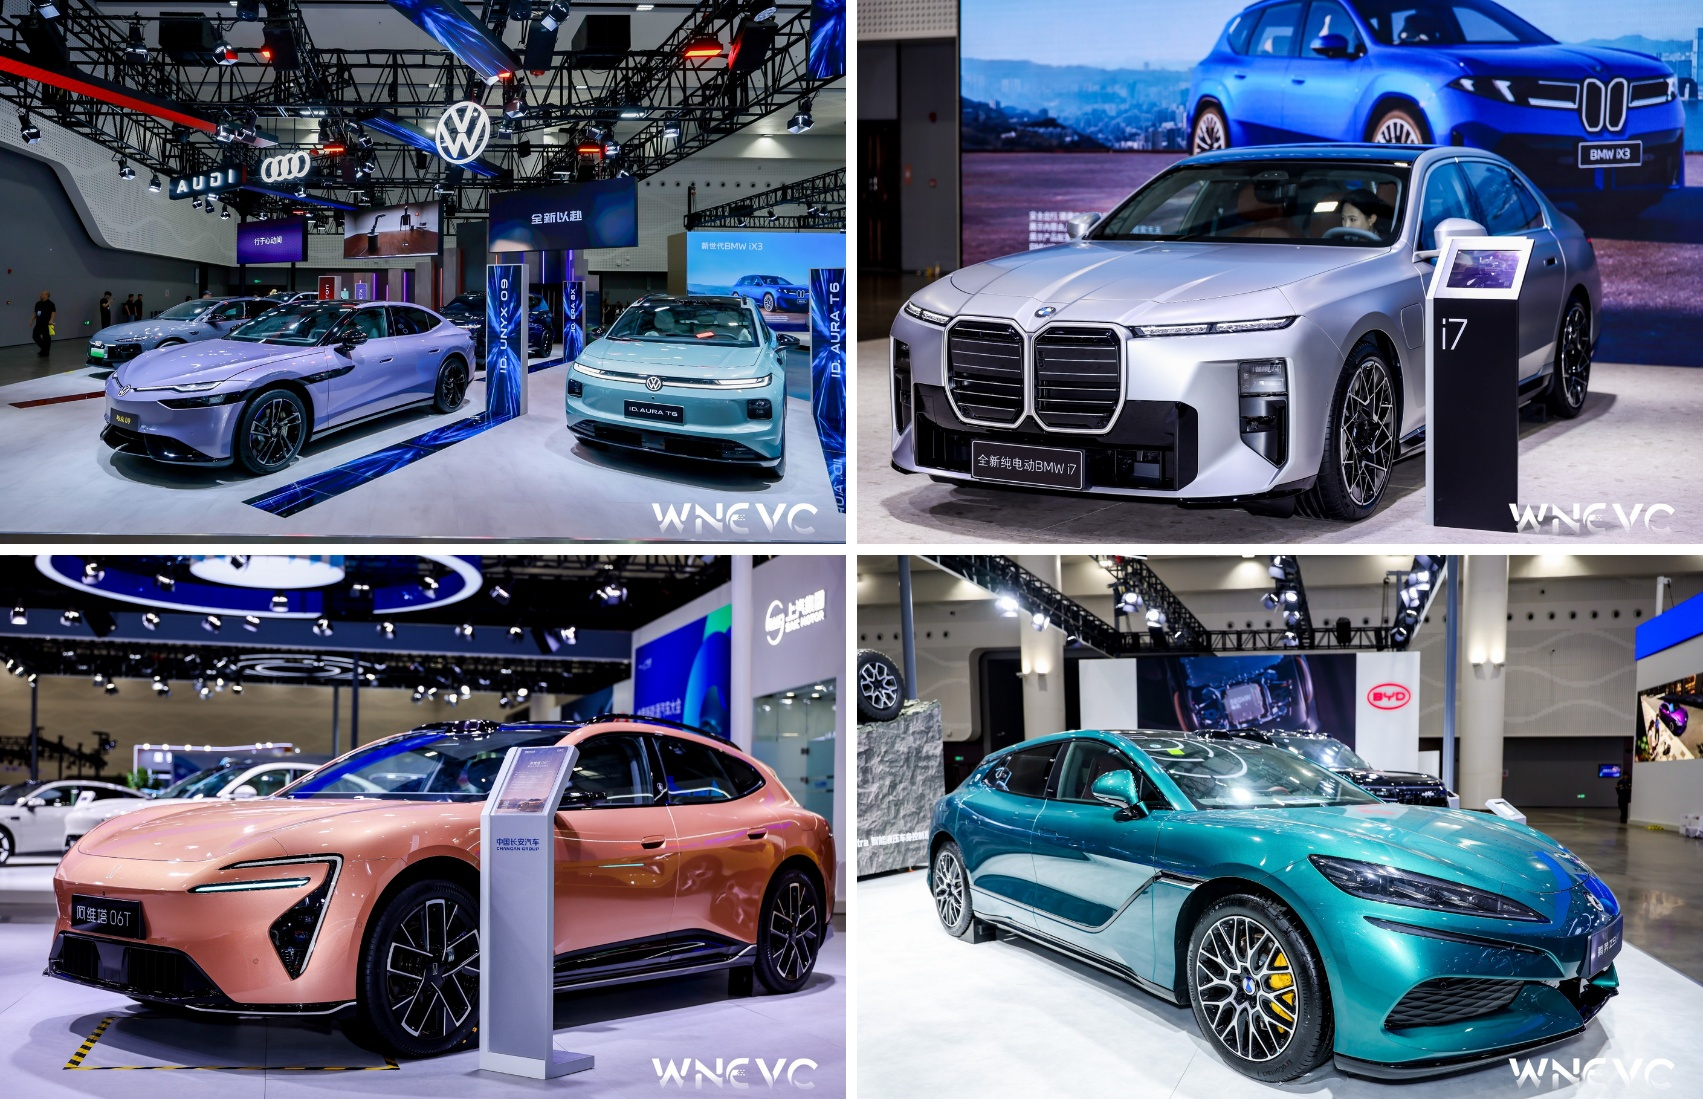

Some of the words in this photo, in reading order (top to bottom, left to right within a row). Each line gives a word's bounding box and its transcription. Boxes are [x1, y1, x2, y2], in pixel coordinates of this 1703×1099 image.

[1590, 149, 1614, 160] BMW
[176, 169, 233, 193] AUDI
[531, 210, 582, 225] 全新以赴
[701, 242, 747, 250] 新世代BMW
[748, 242, 763, 250] iX3
[500, 279, 508, 301] 09
[829, 282, 840, 304] T6
[500, 307, 508, 350] UNYX
[830, 310, 841, 354] AURA
[1442, 318, 1468, 350] i7
[831, 360, 841, 378] ID.
[639, 407, 664, 415] AURA
[977, 454, 1065, 475] 全新纯电动BMW
[1067, 463, 1077, 475] i7
[1373, 691, 1405, 701] BYD
[496, 838, 539, 846] 中国长安汽车
[77, 905, 108, 924] 阿维塔
[109, 910, 131, 927] 06T
